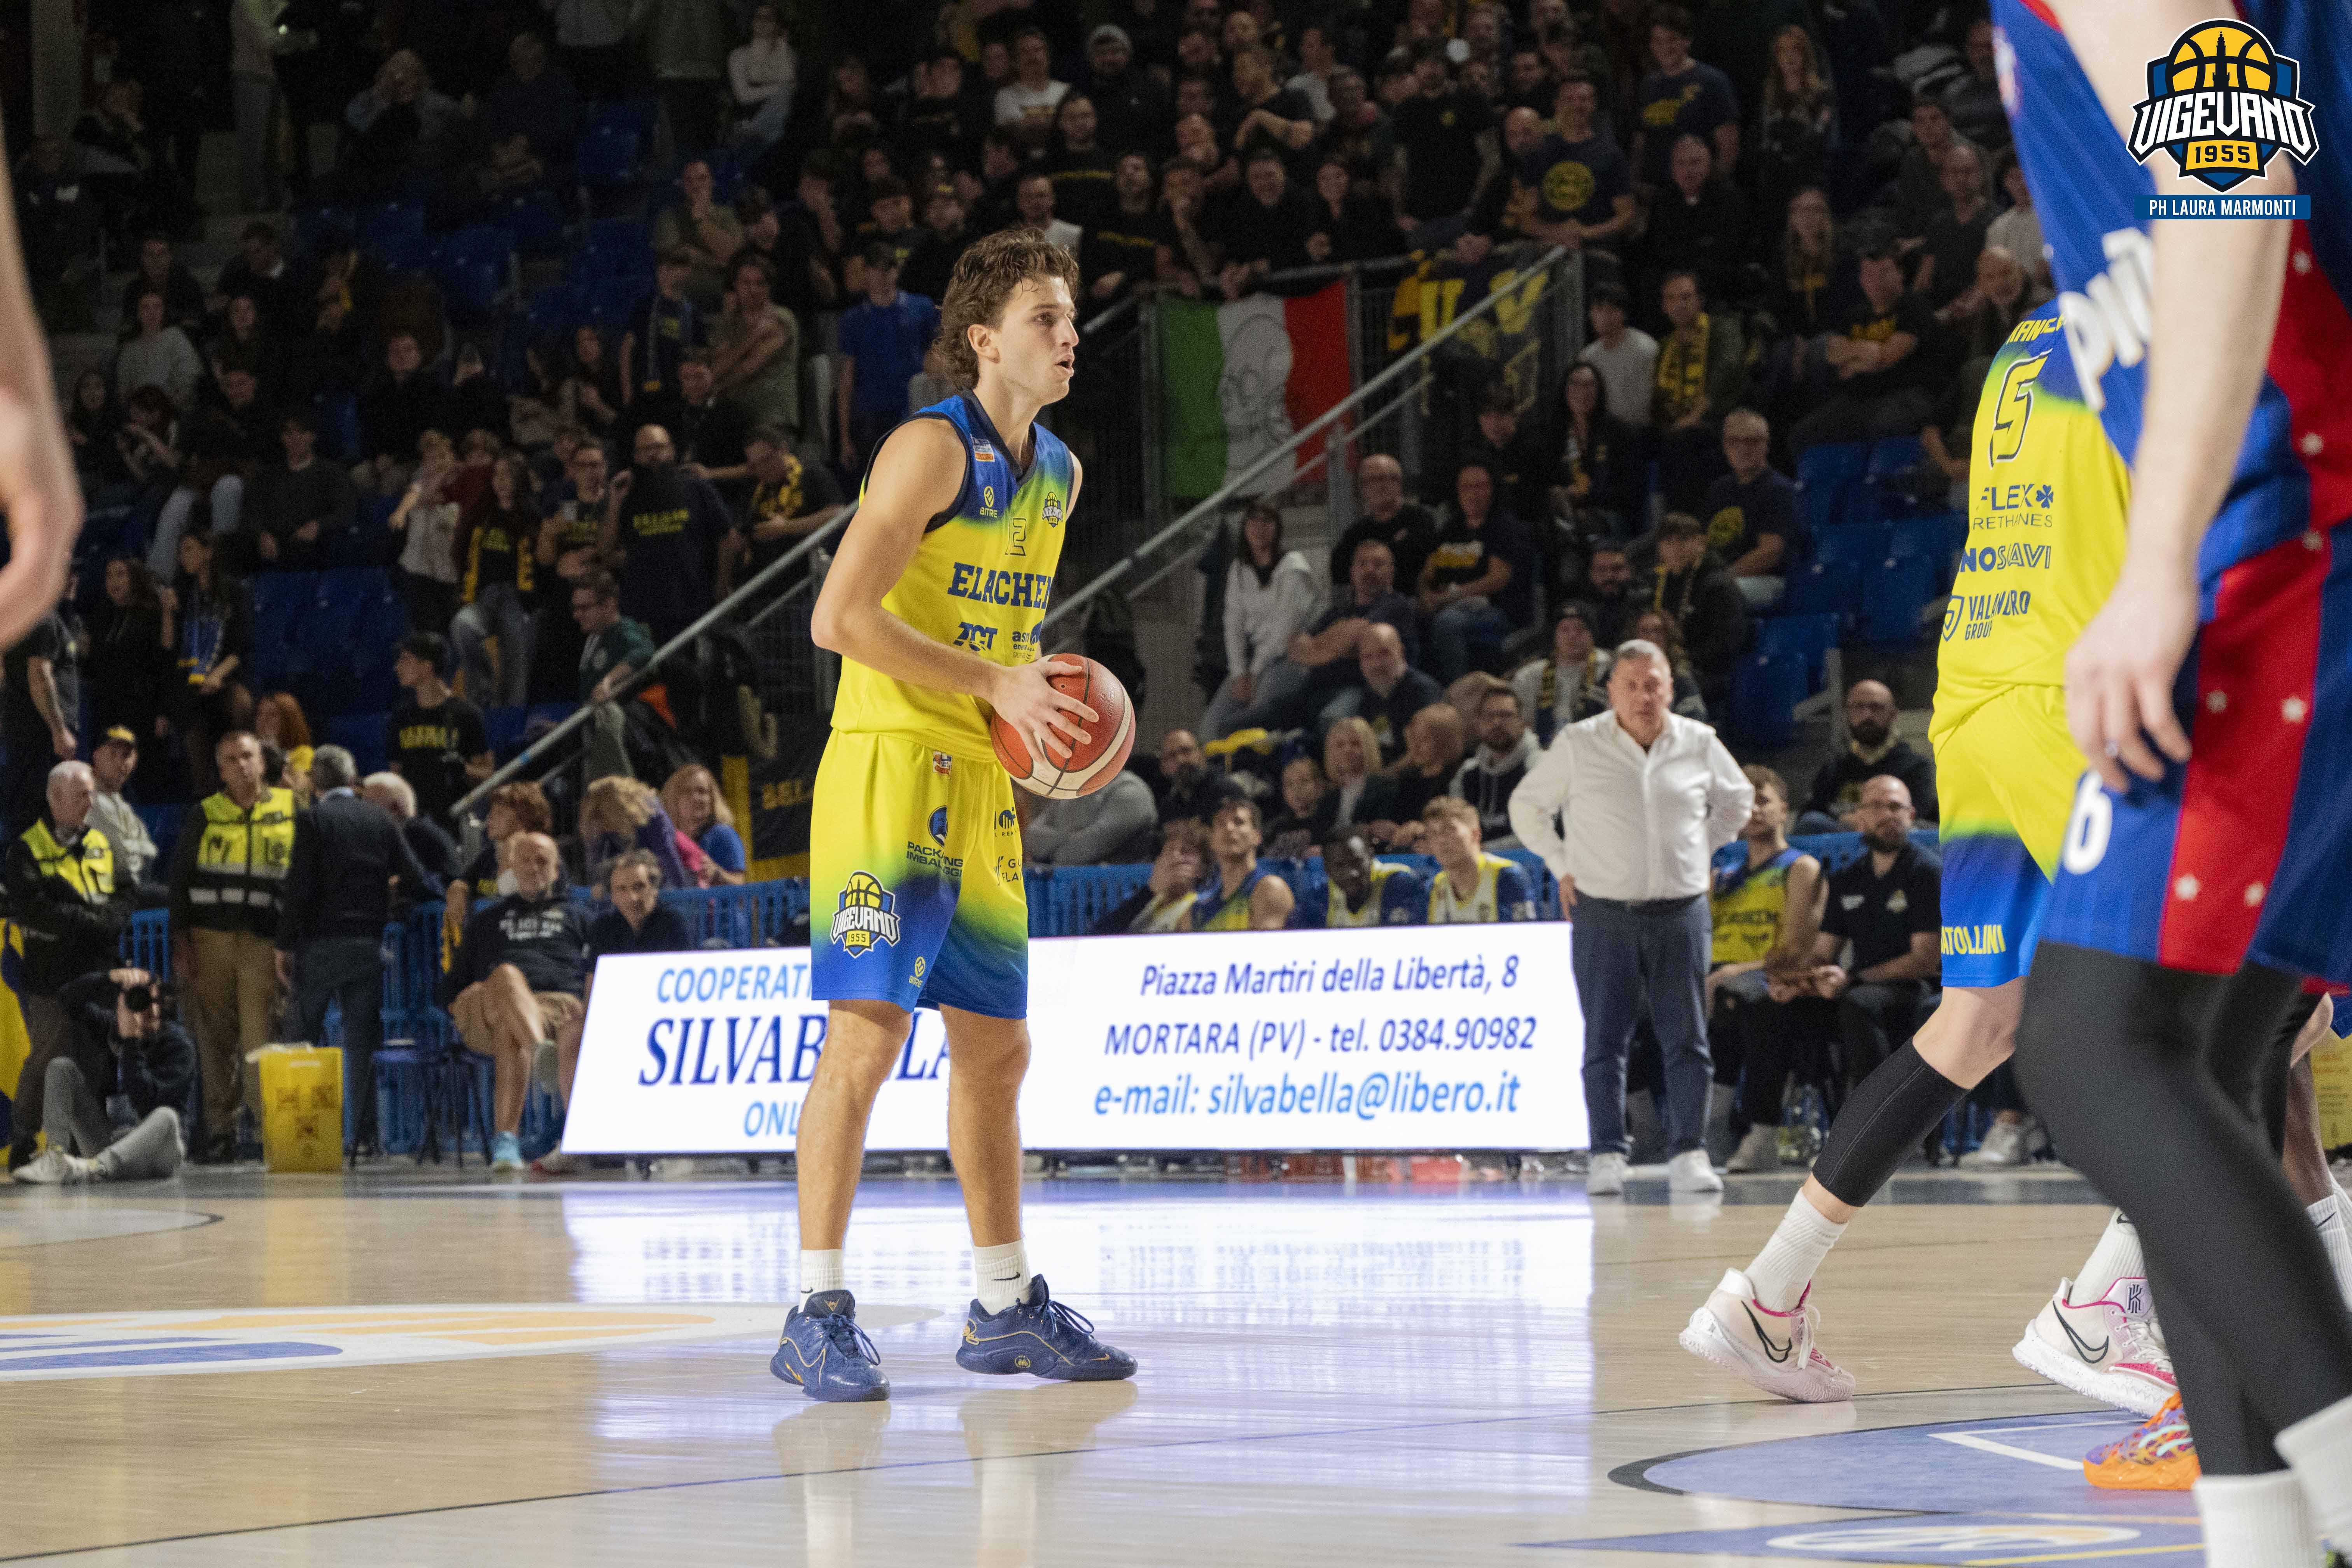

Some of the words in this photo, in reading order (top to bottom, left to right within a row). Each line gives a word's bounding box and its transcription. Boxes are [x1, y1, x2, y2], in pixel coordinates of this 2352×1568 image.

[1988, 348, 2053, 469] 5
[980, 507, 998, 518] BITRE
[831, 906, 896, 941] VIGEVANO
[848, 933, 866, 943] 1955
[908, 975, 924, 988] BITRE
[1140, 964, 1217, 996] Piazza
[1224, 961, 1317, 995] Martiri
[1321, 959, 1384, 993] della
[1392, 954, 1493, 994] Libertà,
[1501, 954, 1520, 989] 8
[1103, 1022, 1239, 1055] MORTARA
[1249, 1018, 1306, 1061] (PV)
[1330, 1017, 1369, 1053] tel.
[1379, 1016, 1537, 1052] 0384.90982
[1093, 1073, 1200, 1115] e-mail:
[1207, 1069, 1521, 1122] silvabella@libero.it
